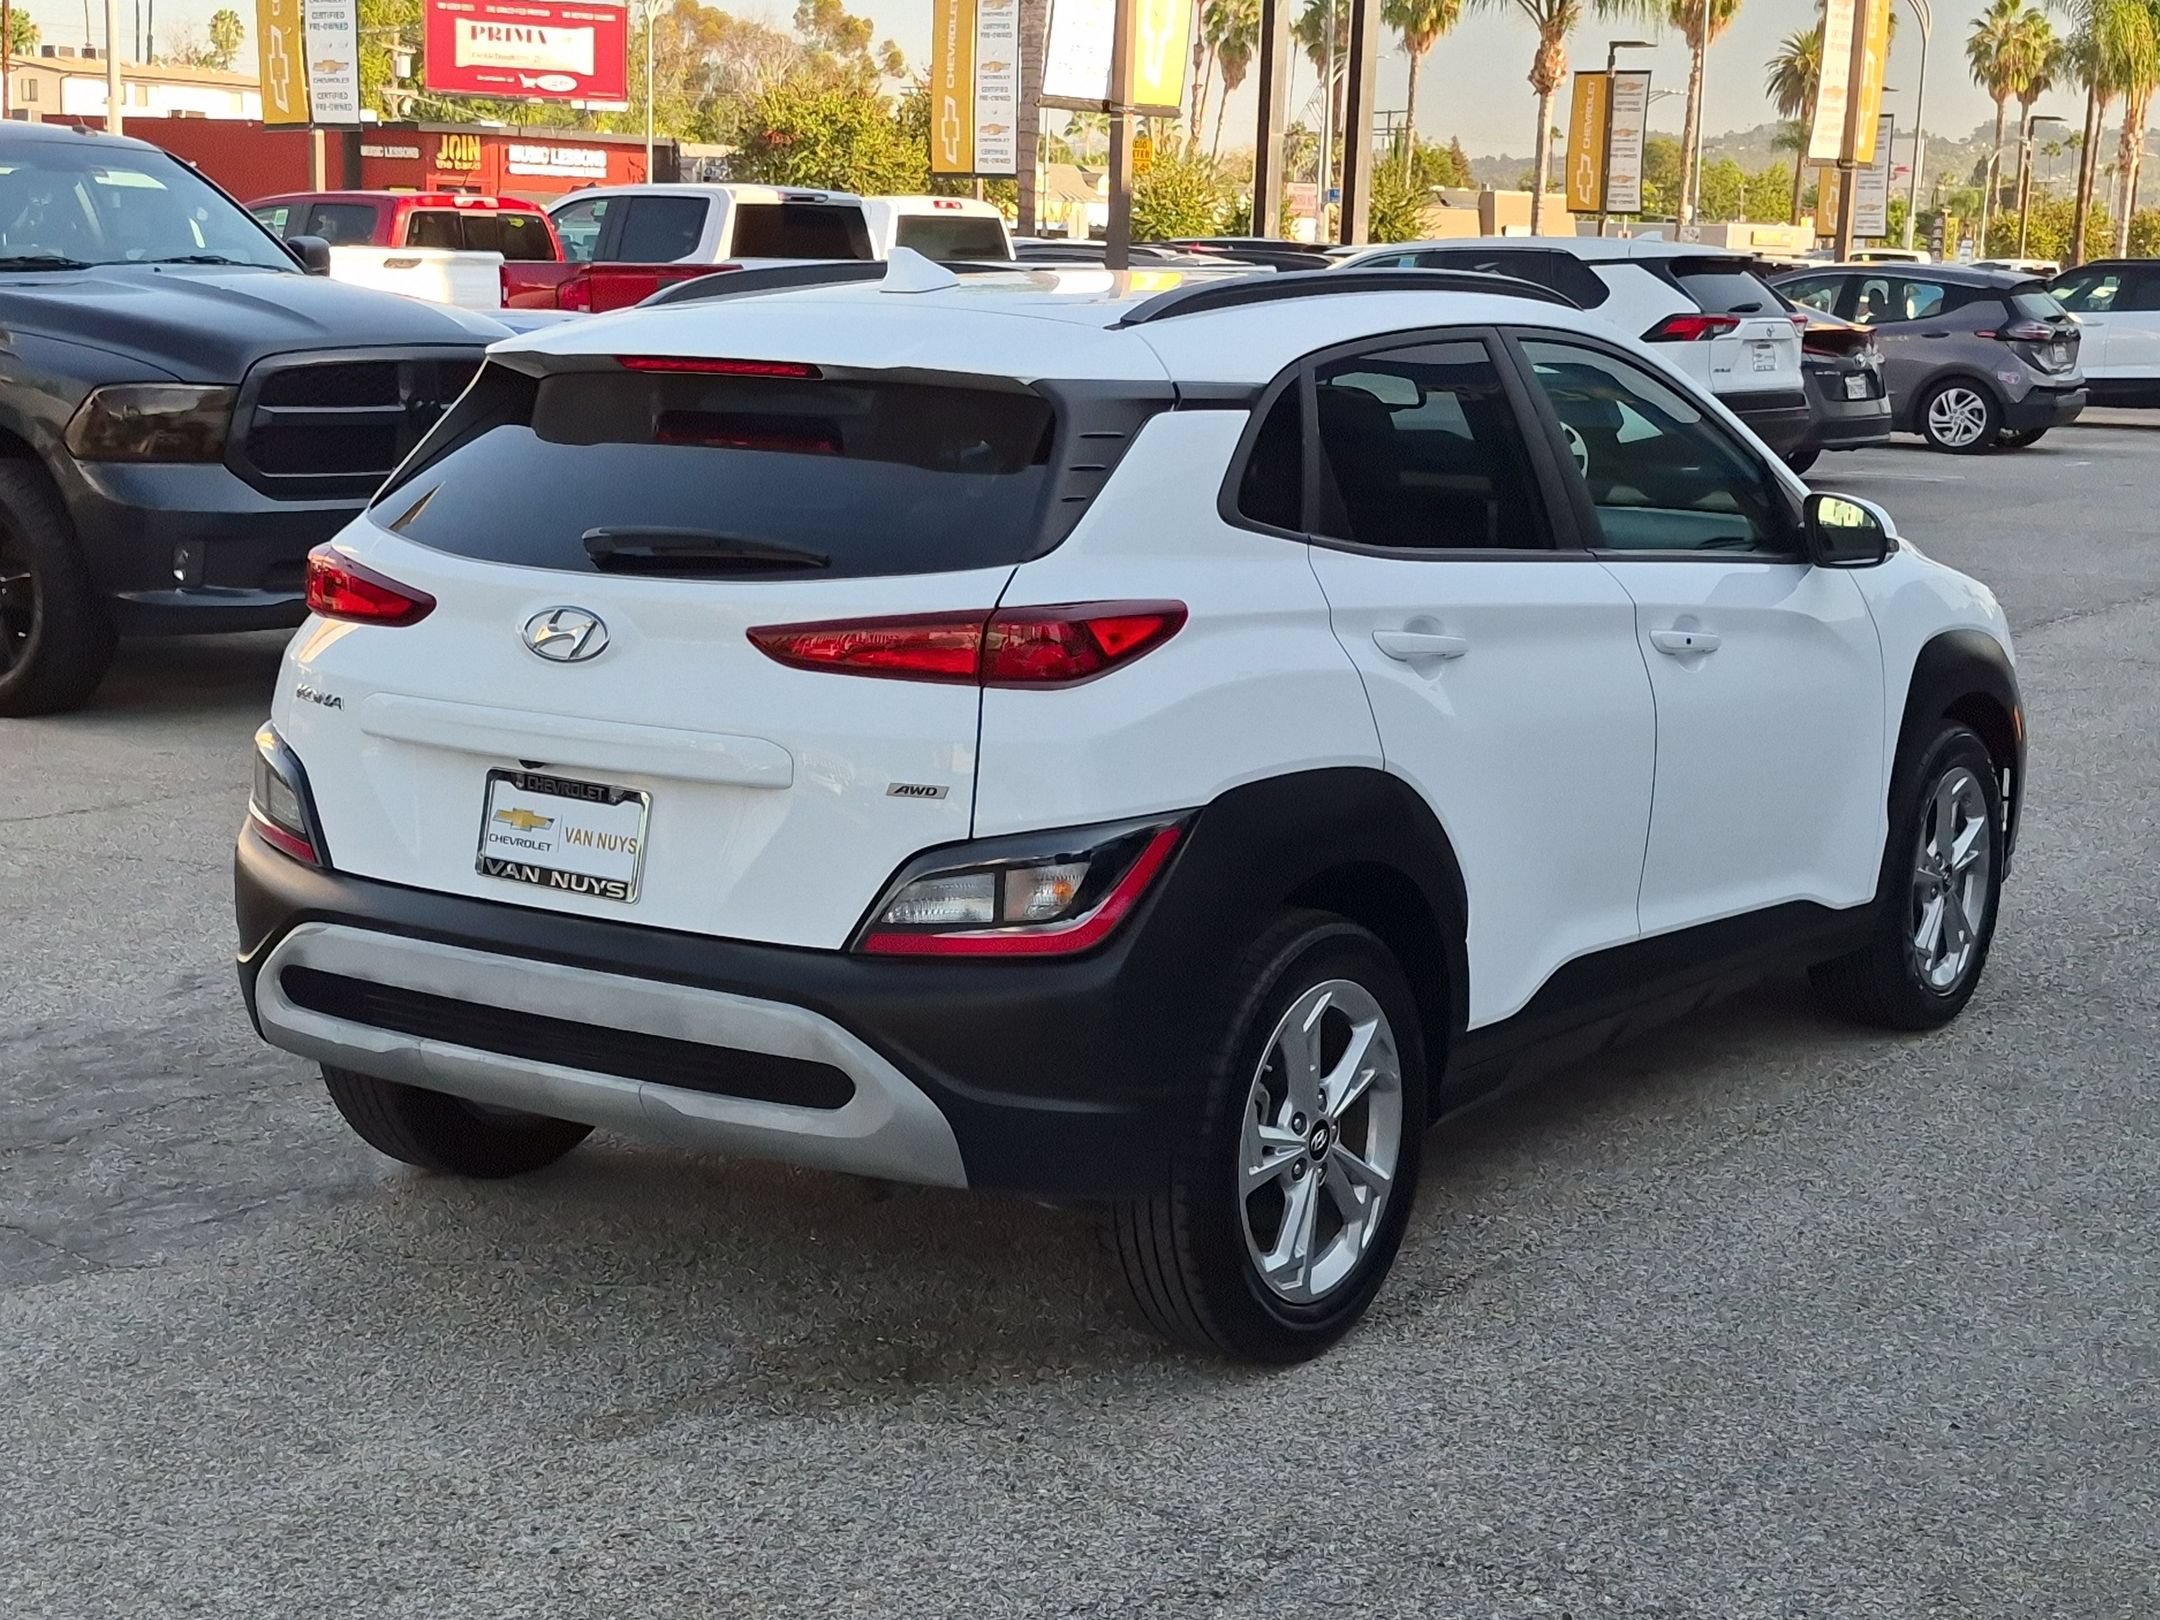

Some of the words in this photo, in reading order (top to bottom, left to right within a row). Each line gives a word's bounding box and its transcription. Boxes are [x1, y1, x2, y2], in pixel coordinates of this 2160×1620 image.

[946, 0, 959, 89] CHEVROLET
[1582, 81, 1596, 150] CHEVROLET
[436, 134, 481, 161] JOIN
[296, 684, 344, 711] KONA
[526, 774, 606, 800] CHEVROLET
[893, 785, 938, 796] AWD
[488, 832, 553, 852] CHEVROLET
[565, 826, 594, 848] VAN
[596, 831, 638, 855] NUYS
[485, 858, 541, 883] VAN
[549, 871, 627, 899] NUYS
